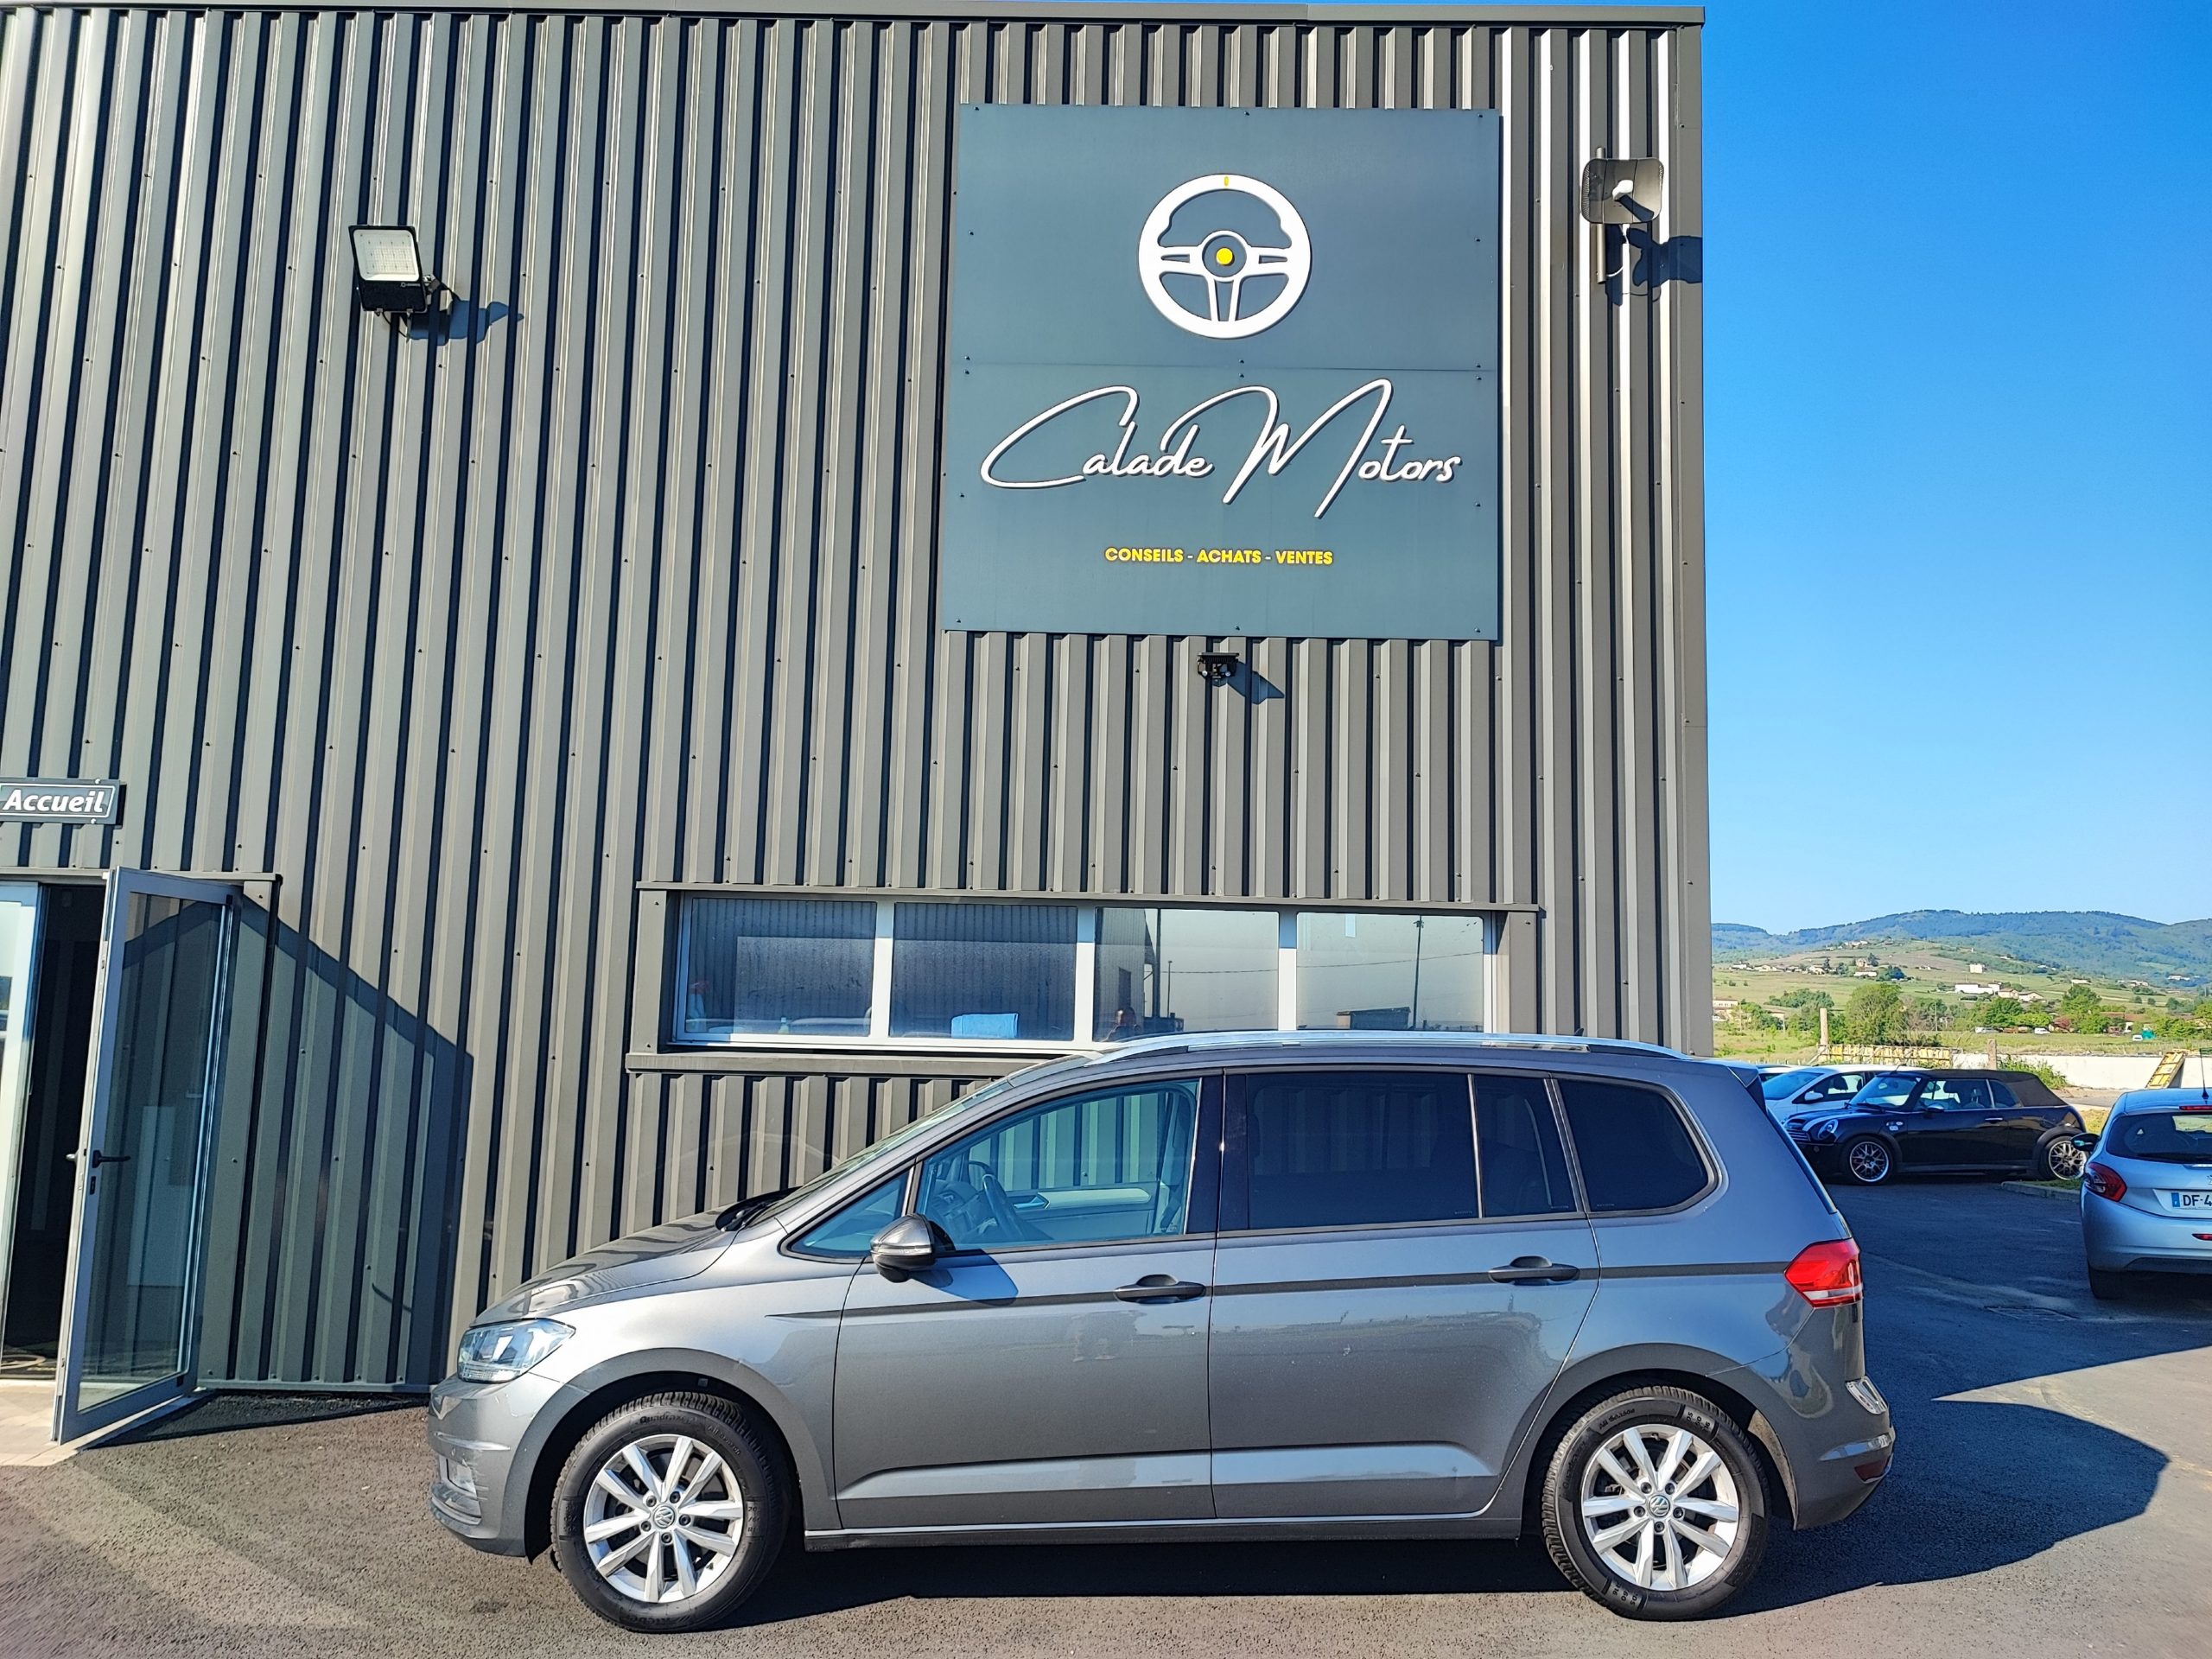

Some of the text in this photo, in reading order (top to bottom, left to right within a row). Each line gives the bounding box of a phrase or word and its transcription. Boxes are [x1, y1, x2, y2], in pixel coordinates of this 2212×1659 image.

[980, 378, 1462, 518] Calade Motors
[1105, 547, 1184, 563] CONSEILS
[1197, 550, 1262, 563] ACHATS
[1275, 550, 1333, 565] VENTES
[3, 789, 105, 813] Accueil
